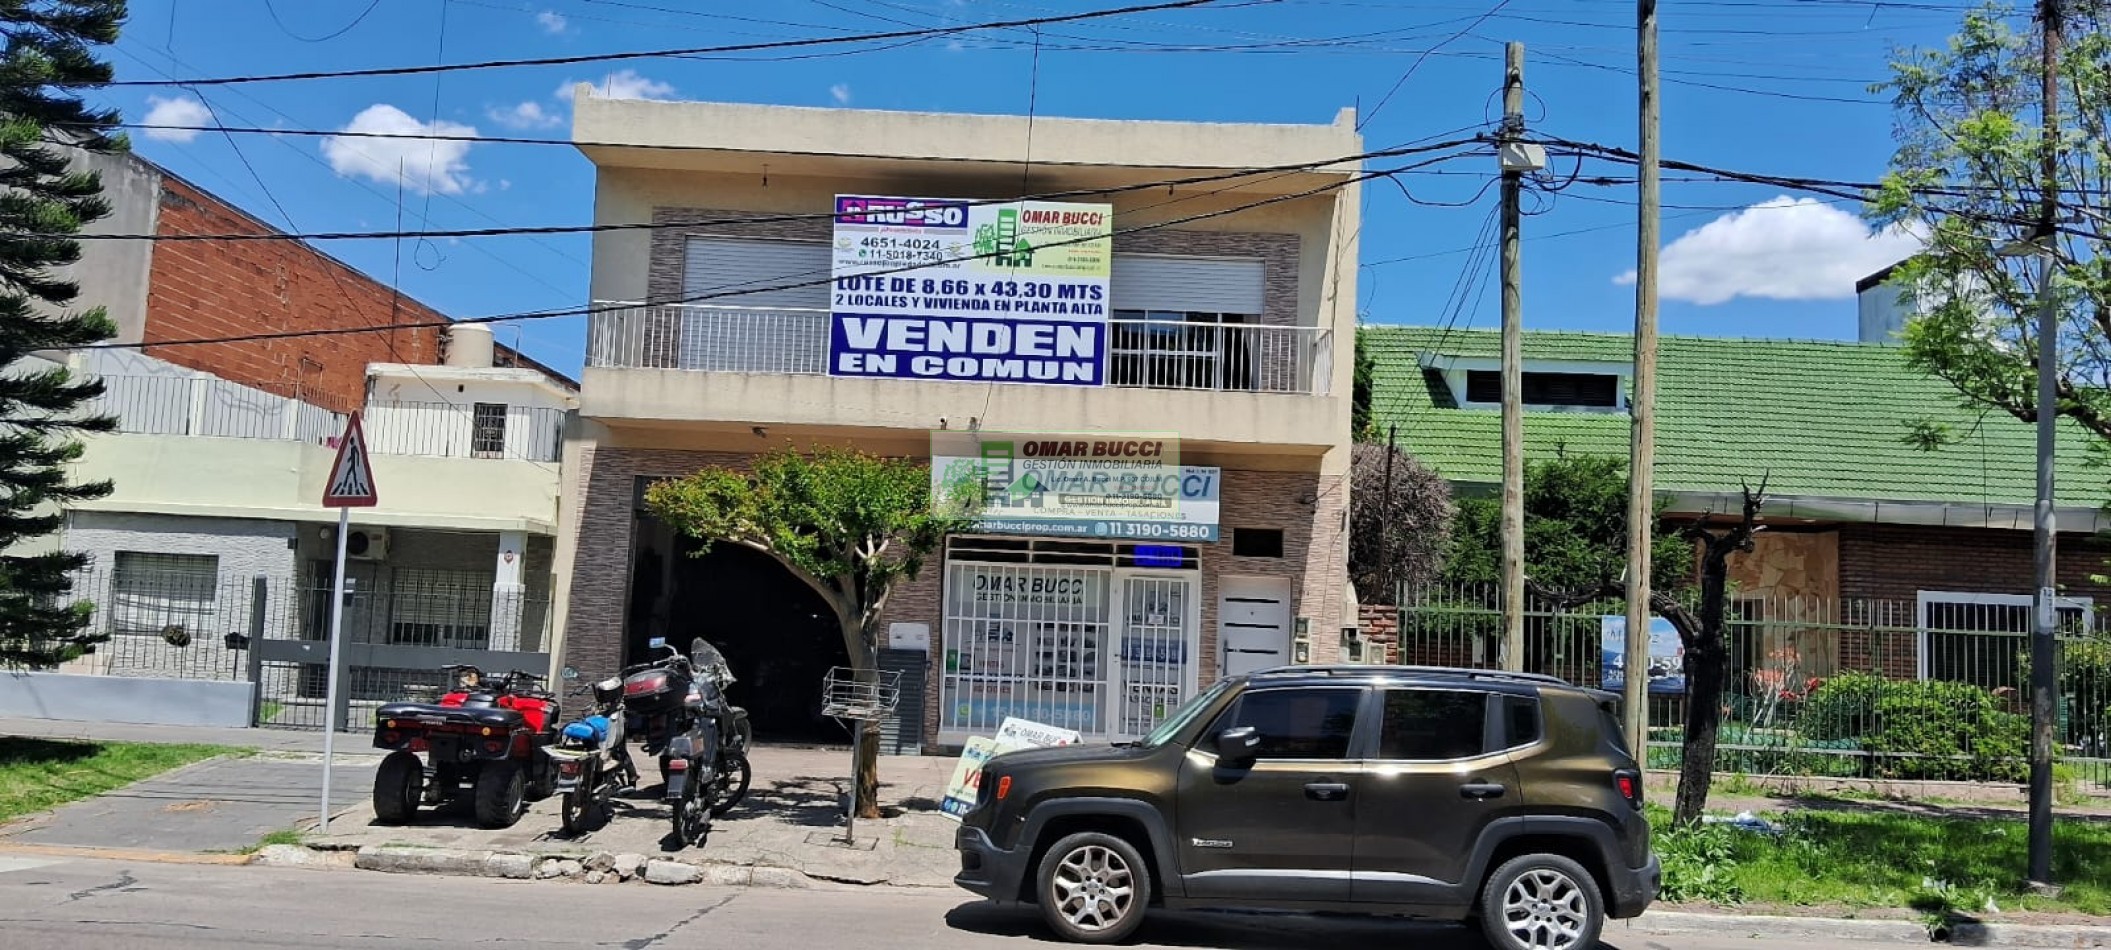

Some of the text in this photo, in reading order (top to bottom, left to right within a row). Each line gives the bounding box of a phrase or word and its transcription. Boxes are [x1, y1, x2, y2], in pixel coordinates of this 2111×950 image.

[866, 201, 963, 225] RUSSO
[1022, 209, 1103, 226] OMAR BUCCI
[860, 236, 940, 250] 4651-4024
[869, 248, 943, 262] 11-5018-7340
[837, 276, 886, 292] LOTE
[890, 277, 917, 294] DE
[990, 280, 1052, 299] 43,30
[1057, 284, 1103, 300] MTS
[835, 293, 1103, 315] 2 LOCALES Y VIVIENDA EN PLANTA ALTA
[842, 317, 1096, 358] VENDEN
[838, 352, 1094, 382] EN COMUN
[1022, 469, 1211, 497] OMAR BUCCI
[1033, 507, 1076, 517] COMPRA
[1085, 509, 1117, 518] VENTA
[1127, 511, 1187, 521] TASACIONES
[1109, 521, 1122, 534] 11
[1127, 523, 1210, 539] 3190-5880
[972, 574, 1028, 592] OMAR
